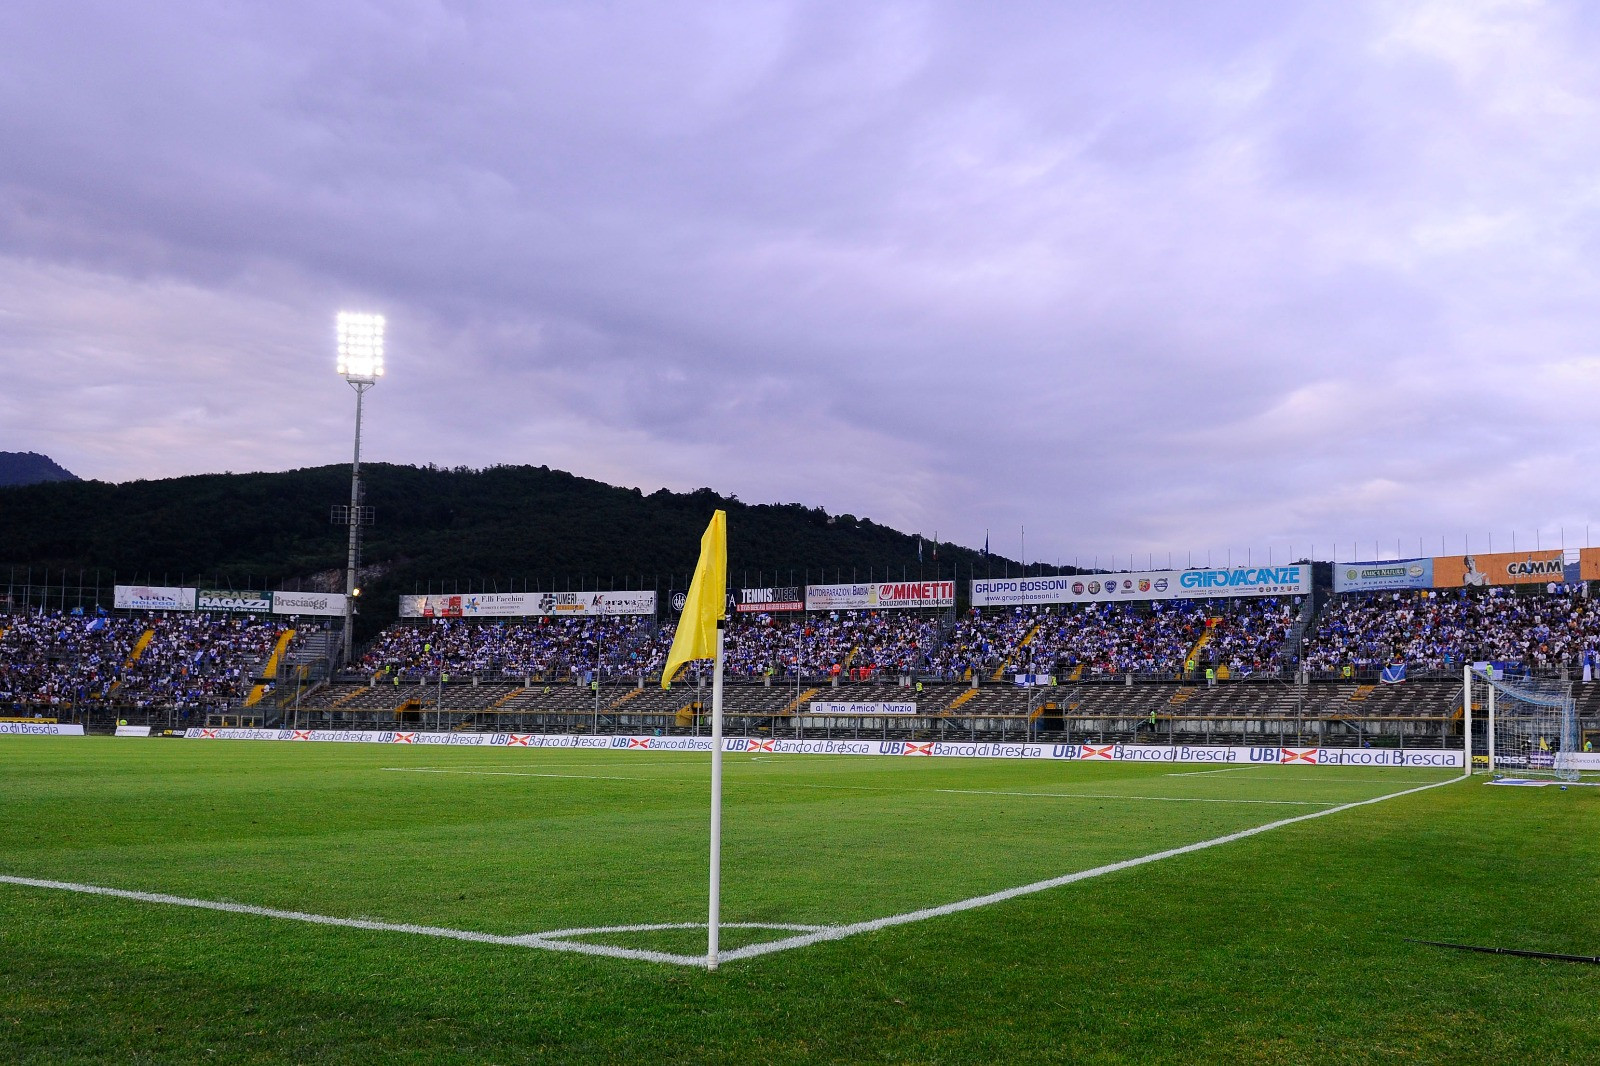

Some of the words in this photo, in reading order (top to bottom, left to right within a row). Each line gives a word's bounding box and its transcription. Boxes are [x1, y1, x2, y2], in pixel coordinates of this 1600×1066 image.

[1507, 561, 1561, 575] CAMM
[1179, 567, 1300, 588] GRIFOVACANZE
[893, 582, 953, 600] MINETTI
[976, 583, 1017, 593] GRUPPO
[1020, 580, 1067, 592] BOSSONI
[199, 590, 261, 600] CESARE
[985, 594, 1060, 602] www.gruppobossoni.it
[198, 598, 270, 609] RAGAZZI
[274, 596, 328, 610] Bresciaoggi
[911, 598, 953, 606] TECNOLOGICHE
[815, 702, 824, 713] al
[882, 703, 912, 713] Nunzio
[21, 723, 59, 734] Brescia
[188, 729, 203, 739] UBI
[278, 730, 294, 740] UBI
[309, 731, 333, 741] Banco
[343, 731, 372, 742] Brescia
[377, 732, 396, 742] UBI
[412, 733, 441, 743] Banco
[450, 734, 484, 745] Brescia
[490, 734, 508, 745] UBI
[528, 734, 559, 746] Banco
[560, 735, 570, 747] di
[570, 735, 607, 747] Brescia
[612, 738, 630, 748] UBI
[648, 738, 677, 749] Banco
[678, 738, 687, 749] di
[687, 739, 714, 750] Bresc
[726, 739, 748, 751] UBI
[773, 740, 809, 752] Banco
[810, 741, 823, 753] di
[825, 741, 870, 754] Brescia
[879, 742, 906, 755] UBI
[933, 743, 975, 756] Banco
[977, 744, 990, 756] di
[991, 744, 1041, 757] Brescia
[1052, 745, 1081, 758] UBI
[1113, 747, 1162, 760] Banco
[1163, 747, 1177, 761] di
[1180, 748, 1236, 762] Brescia
[1249, 748, 1280, 762] UBI
[1317, 750, 1372, 764] Banco
[1374, 750, 1389, 765] di
[1392, 751, 1456, 766] Brescia
